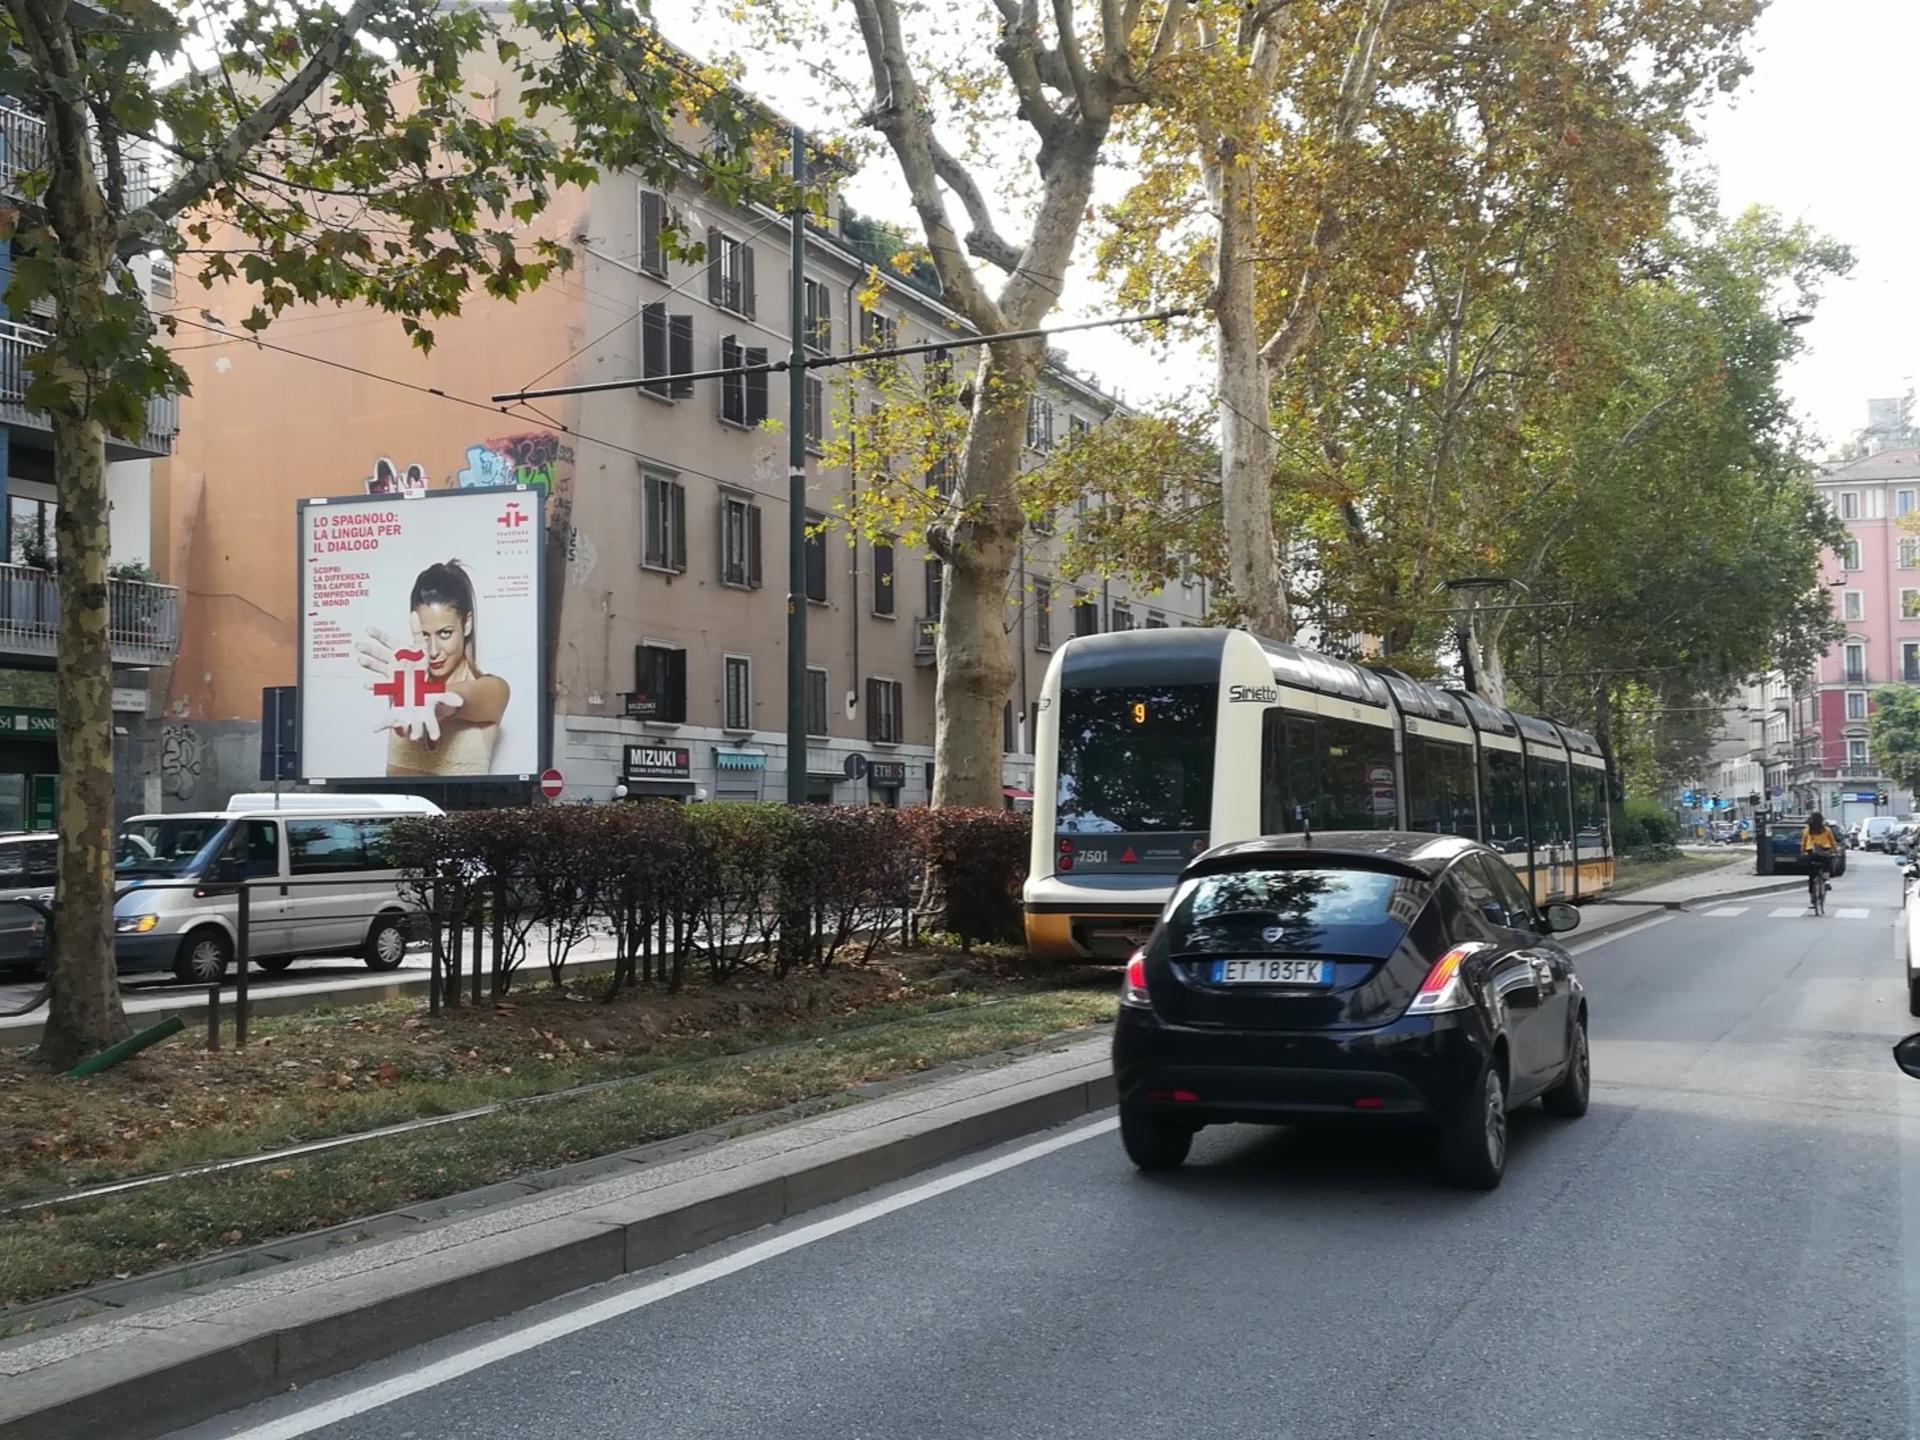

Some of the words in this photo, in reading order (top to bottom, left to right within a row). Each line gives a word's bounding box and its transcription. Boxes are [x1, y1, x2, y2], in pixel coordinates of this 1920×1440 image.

[314, 516, 328, 528] LO
[332, 512, 398, 526] SPAGNOLO:
[314, 529, 328, 540] LA
[332, 526, 374, 539] LINGUA
[378, 524, 401, 536] PER
[314, 542, 324, 553] IL
[328, 539, 379, 552] DIALOGO
[313, 566, 341, 575] SCOPRI
[324, 573, 370, 581] DIFFERENZA
[329, 582, 356, 590] CAPIRE
[313, 589, 369, 599] COMPRENDERE
[322, 599, 350, 607] MONDO
[1229, 685, 1278, 702] Sirietto
[628, 702, 656, 710] MIZUKI
[1133, 703, 1146, 723] 9
[631, 749, 676, 767] MIZUKI
[1079, 850, 1108, 862] 7501
[1226, 961, 1251, 980] ET
[1258, 961, 1319, 981] 183FK
